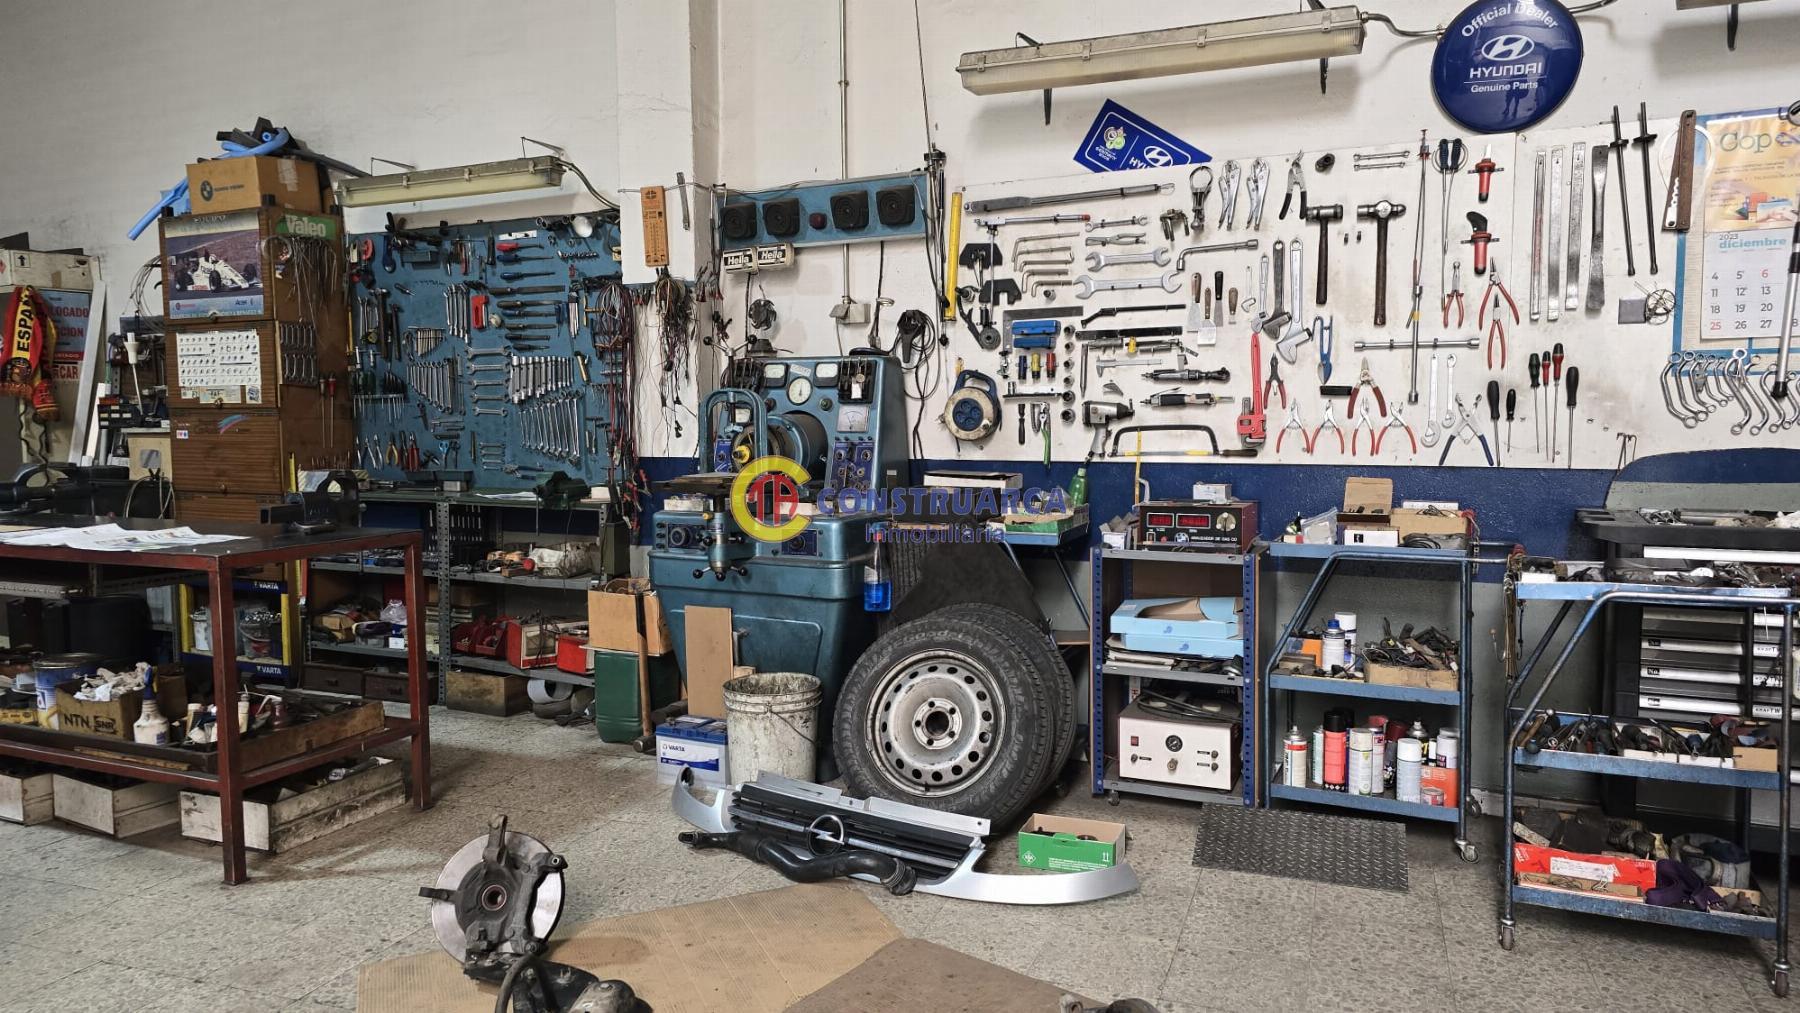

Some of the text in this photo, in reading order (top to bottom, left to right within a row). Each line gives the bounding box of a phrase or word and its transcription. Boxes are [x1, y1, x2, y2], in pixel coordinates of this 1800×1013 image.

[1461, 2, 1559, 37] Official Dealer
[1469, 62, 1542, 79] HYUNDAI
[1471, 81, 1538, 93] Genuine Parts
[284, 214, 327, 238] Valeo
[1719, 238, 1787, 249] diciembre
[727, 255, 750, 265] Hella
[760, 250, 783, 260] Hella
[1711, 272, 1719, 280] 4
[1761, 269, 1769, 279] 6
[1711, 288, 1719, 298] 11
[1761, 286, 1772, 295] 13
[1710, 303, 1773, 314] 18 19 20
[1710, 321, 1722, 331] 25
[1735, 321, 1748, 330] 26
[1760, 319, 1773, 329] 27
[261, 666, 282, 675] VARTA
[63, 713, 91, 728] NTN
